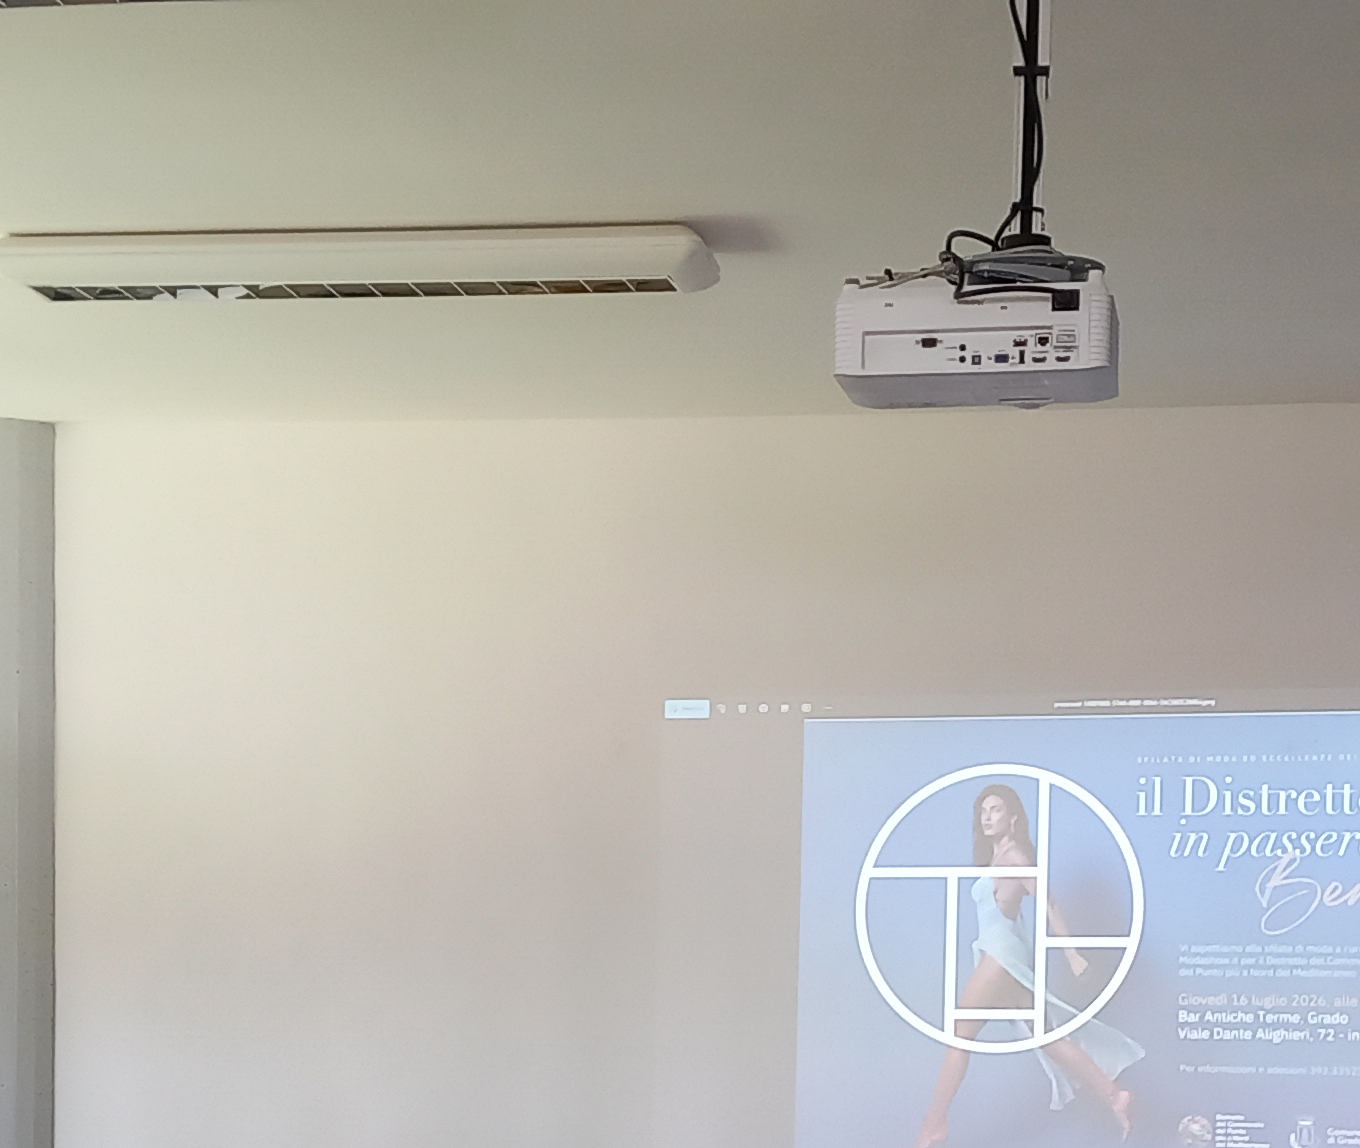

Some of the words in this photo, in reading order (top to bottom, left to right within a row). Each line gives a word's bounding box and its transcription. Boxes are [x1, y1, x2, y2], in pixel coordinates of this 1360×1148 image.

[1136, 776, 1163, 816] il
[1169, 818, 1209, 858] in
[1251, 994, 1288, 1010] luglio
[1178, 1010, 1201, 1023] Bar
[1204, 1010, 1255, 1023] Antiche
[1257, 1011, 1305, 1026] Terme,
[1307, 1012, 1349, 1025] Grado
[1177, 1027, 1211, 1040] Viale
[1213, 1027, 1253, 1040] Dante
[1255, 1028, 1314, 1044] Alighieri,
[1316, 1029, 1336, 1042] 72
